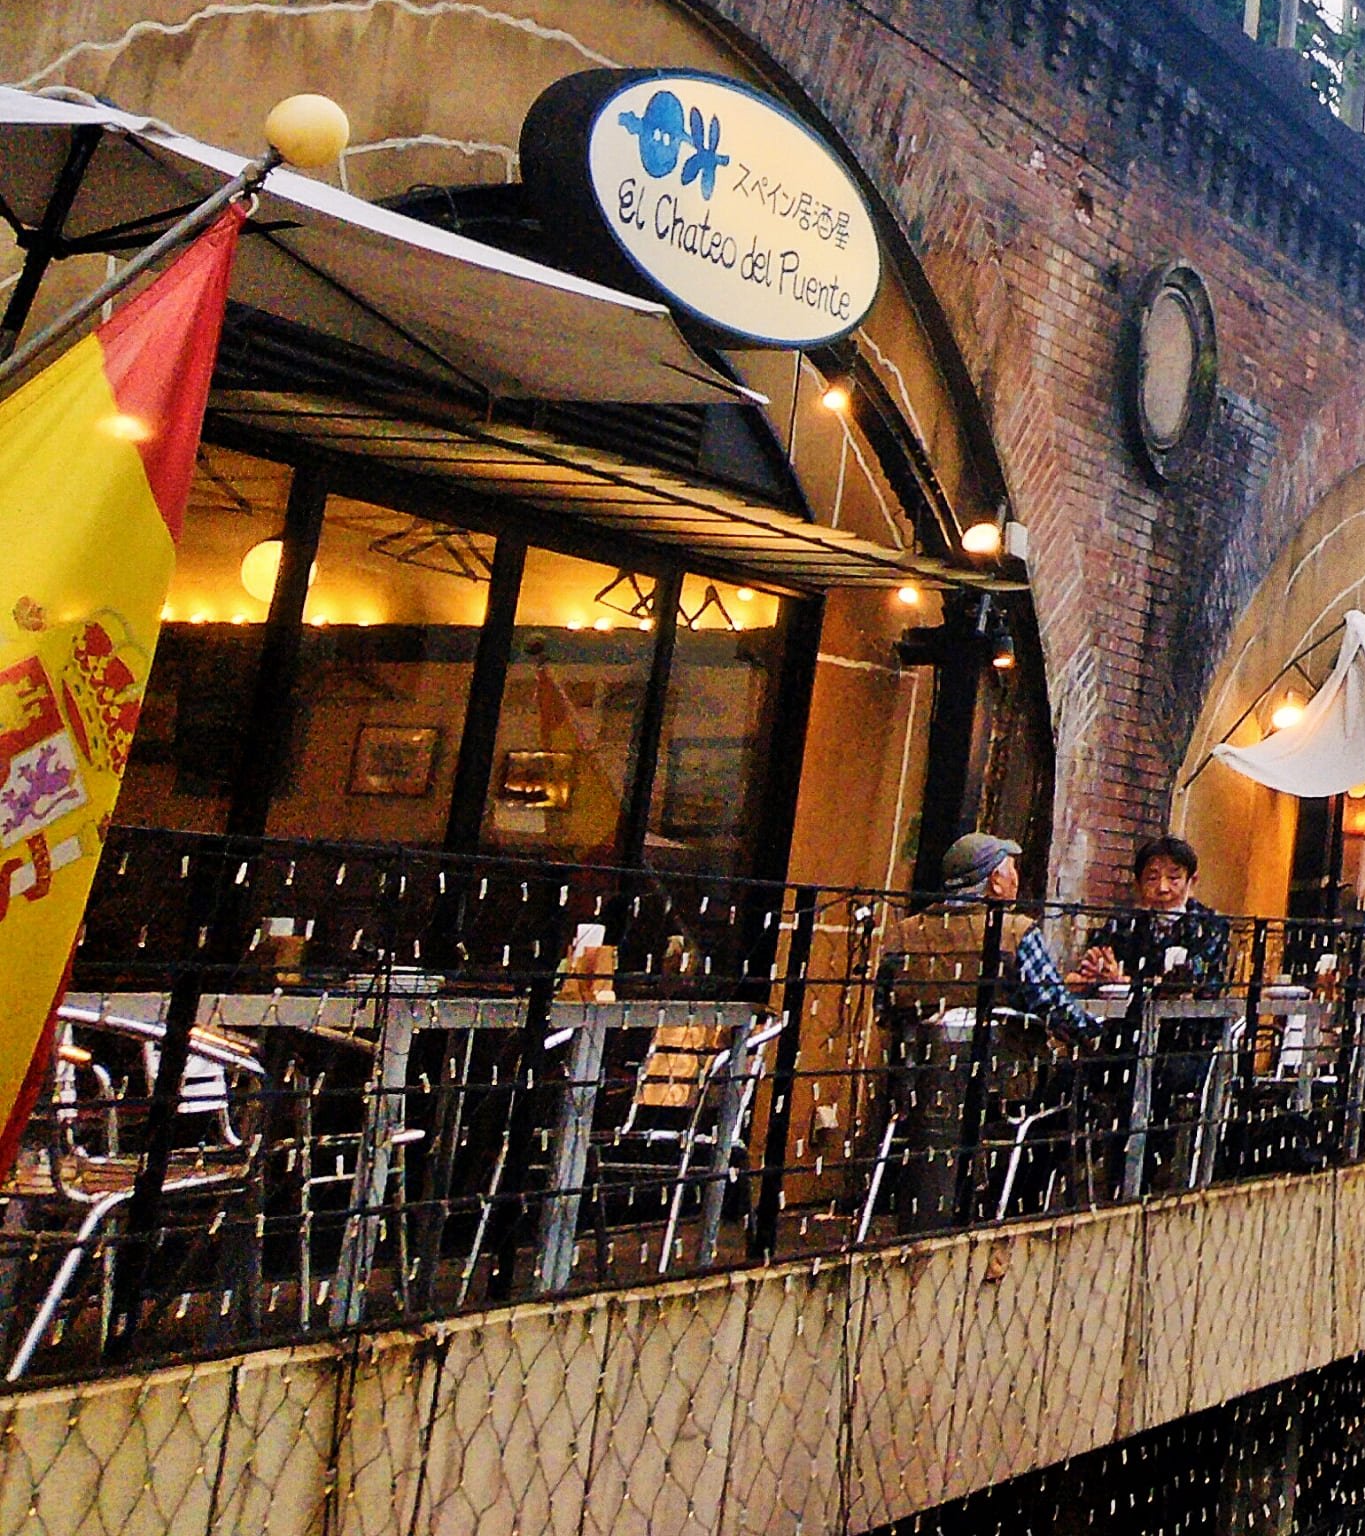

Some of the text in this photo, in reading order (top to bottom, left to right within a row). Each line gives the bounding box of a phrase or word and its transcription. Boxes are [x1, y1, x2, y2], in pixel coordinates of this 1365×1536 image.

[654, 194, 737, 270] Chateo
[740, 235, 773, 289] del
[779, 250, 852, 322] Puente
[733, 162, 852, 251] スペイン居酒屋
